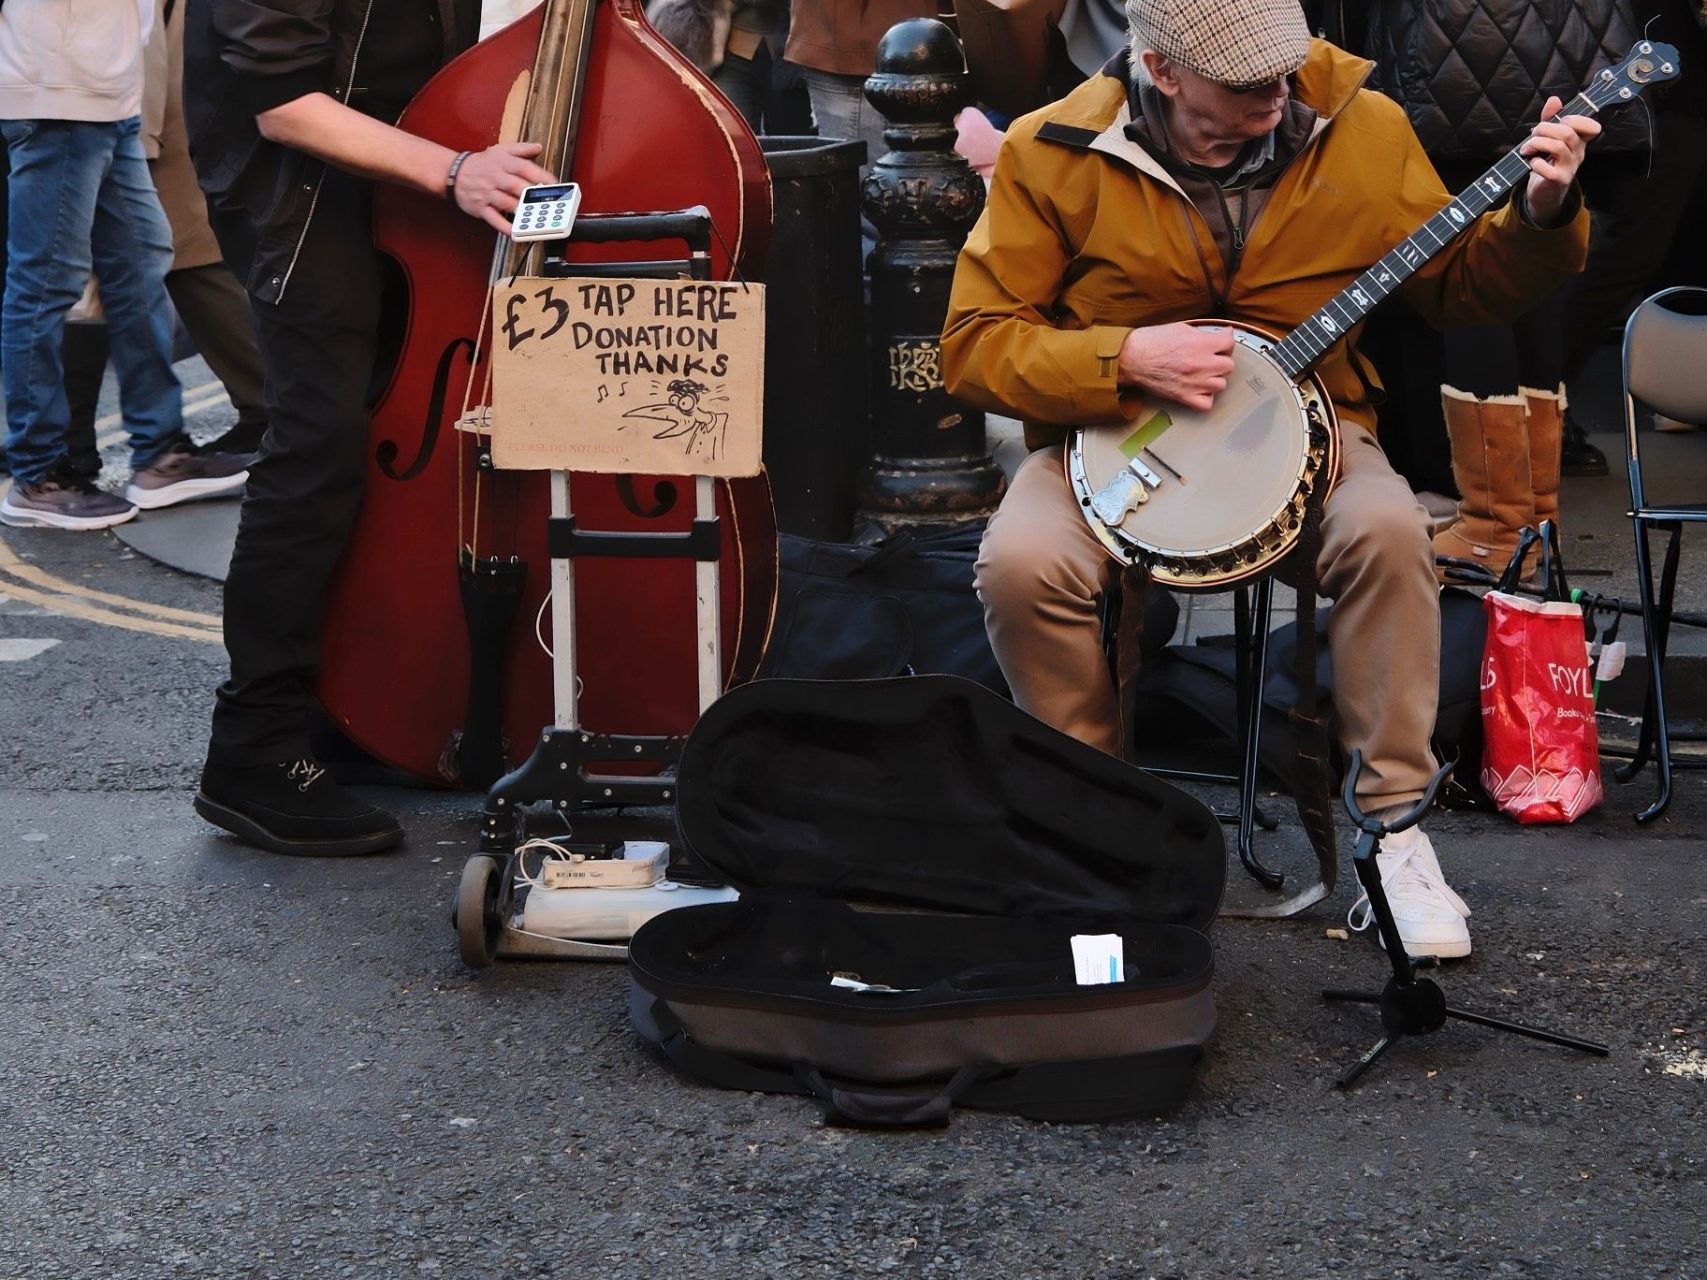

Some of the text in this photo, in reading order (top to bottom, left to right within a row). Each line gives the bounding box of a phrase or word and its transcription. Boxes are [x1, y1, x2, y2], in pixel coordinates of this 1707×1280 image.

[502, 284, 737, 351] £3 TAP HERE
[572, 322, 718, 352] DONATION
[595, 353, 729, 377] THANKS
